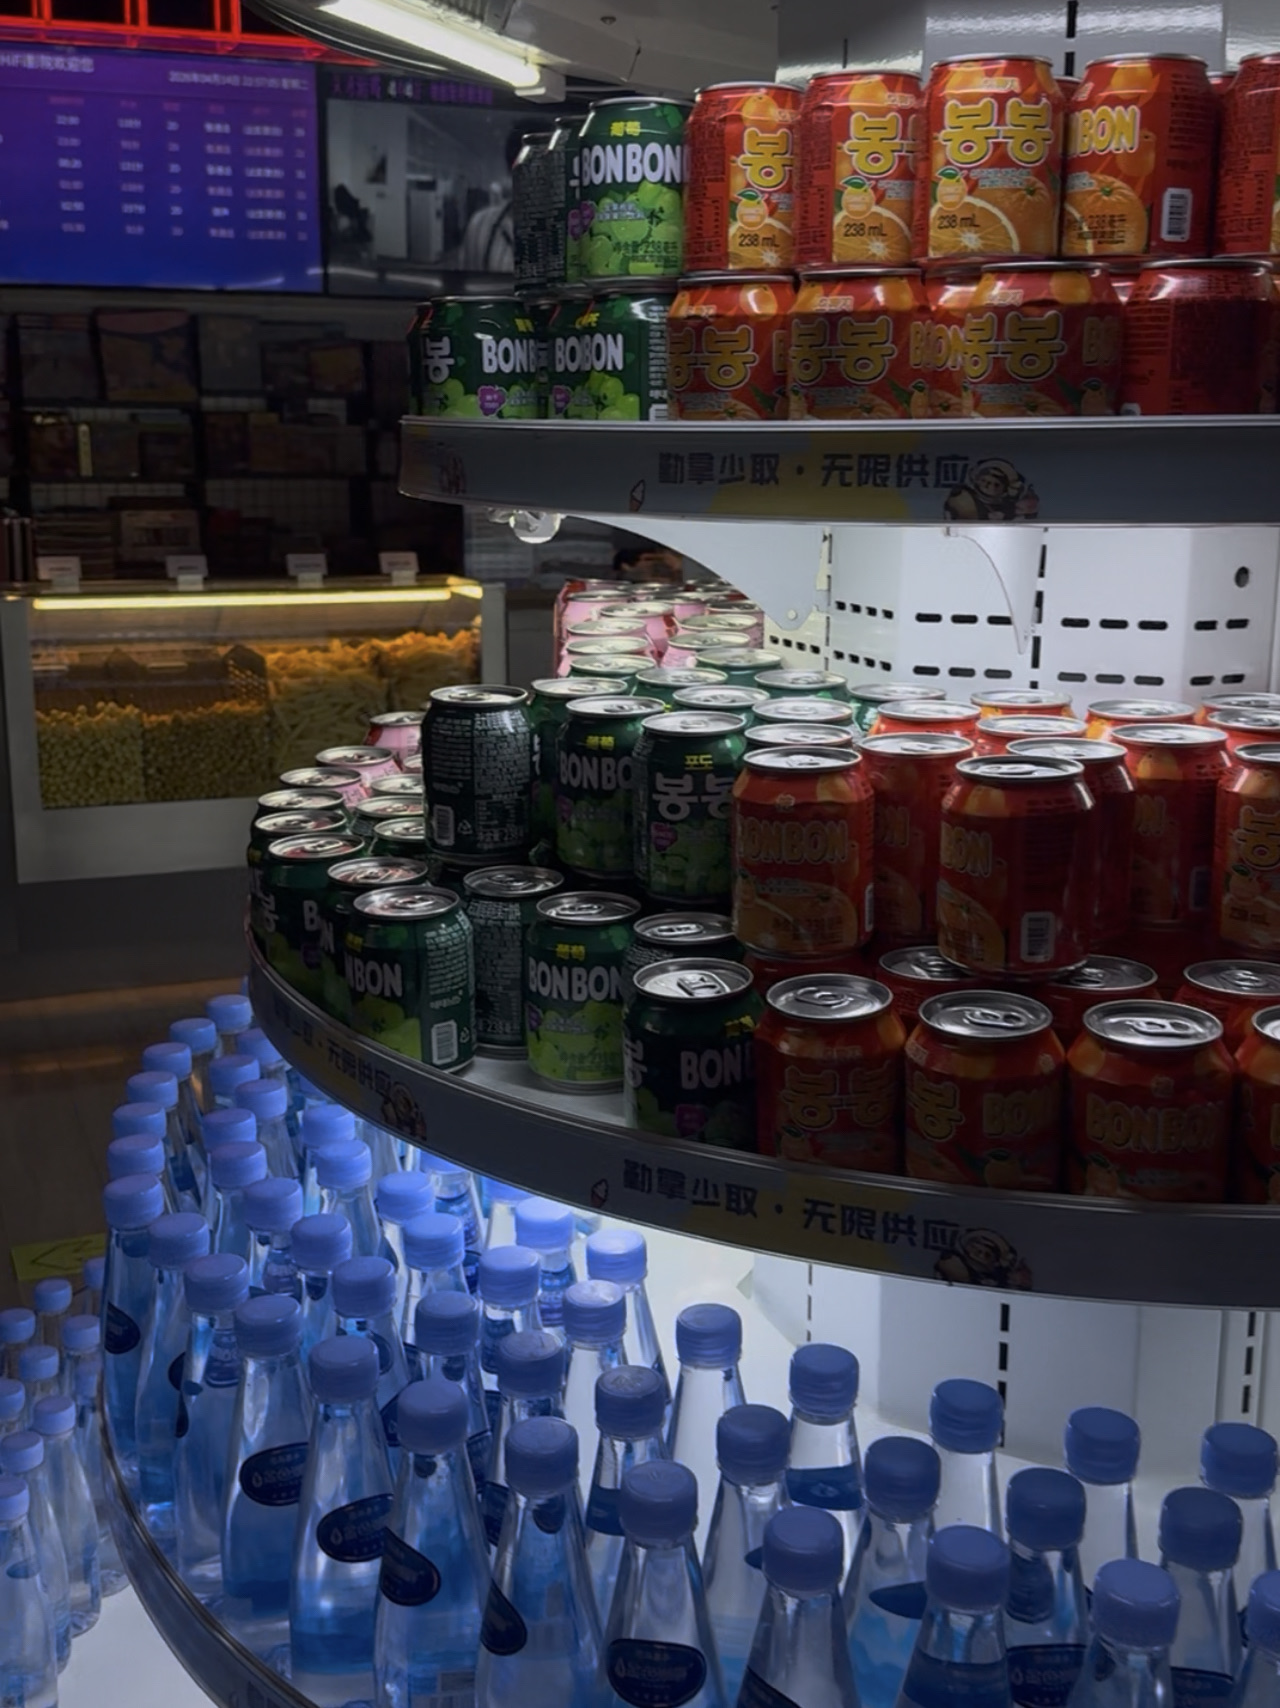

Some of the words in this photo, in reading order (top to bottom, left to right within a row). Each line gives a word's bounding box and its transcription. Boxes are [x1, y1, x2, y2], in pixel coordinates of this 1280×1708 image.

[941, 97, 1053, 168] 봉봉
[937, 215, 957, 229] 238
[844, 223, 865, 237] 238
[867, 223, 889, 237] mL
[738, 234, 759, 247] 238
[761, 235, 780, 247] mL
[791, 315, 897, 384] 봉봉
